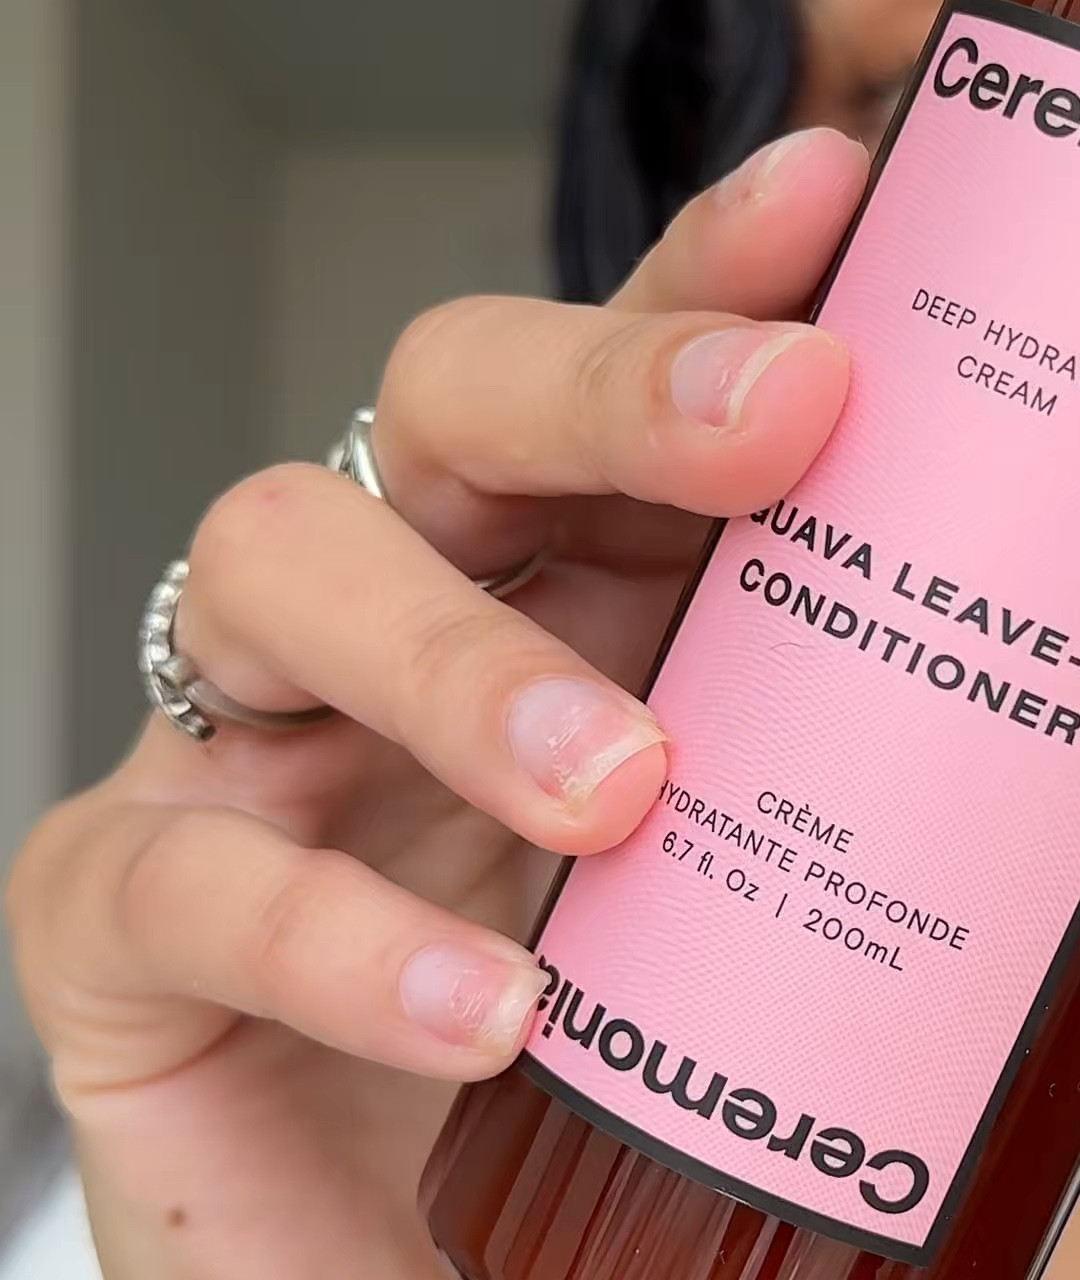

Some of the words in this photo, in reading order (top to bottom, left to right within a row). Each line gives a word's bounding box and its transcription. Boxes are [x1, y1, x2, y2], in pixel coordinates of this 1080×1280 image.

[912, 288, 977, 330] DEEP
[957, 356, 1058, 417] CREAM
[757, 791, 854, 854] CRÈME
[662, 831, 695, 862] 6.7
[697, 851, 715, 880] fl.
[726, 869, 760, 902] Oz
[803, 908, 904, 972] 200mL
[804, 861, 970, 951] PROFONDE
